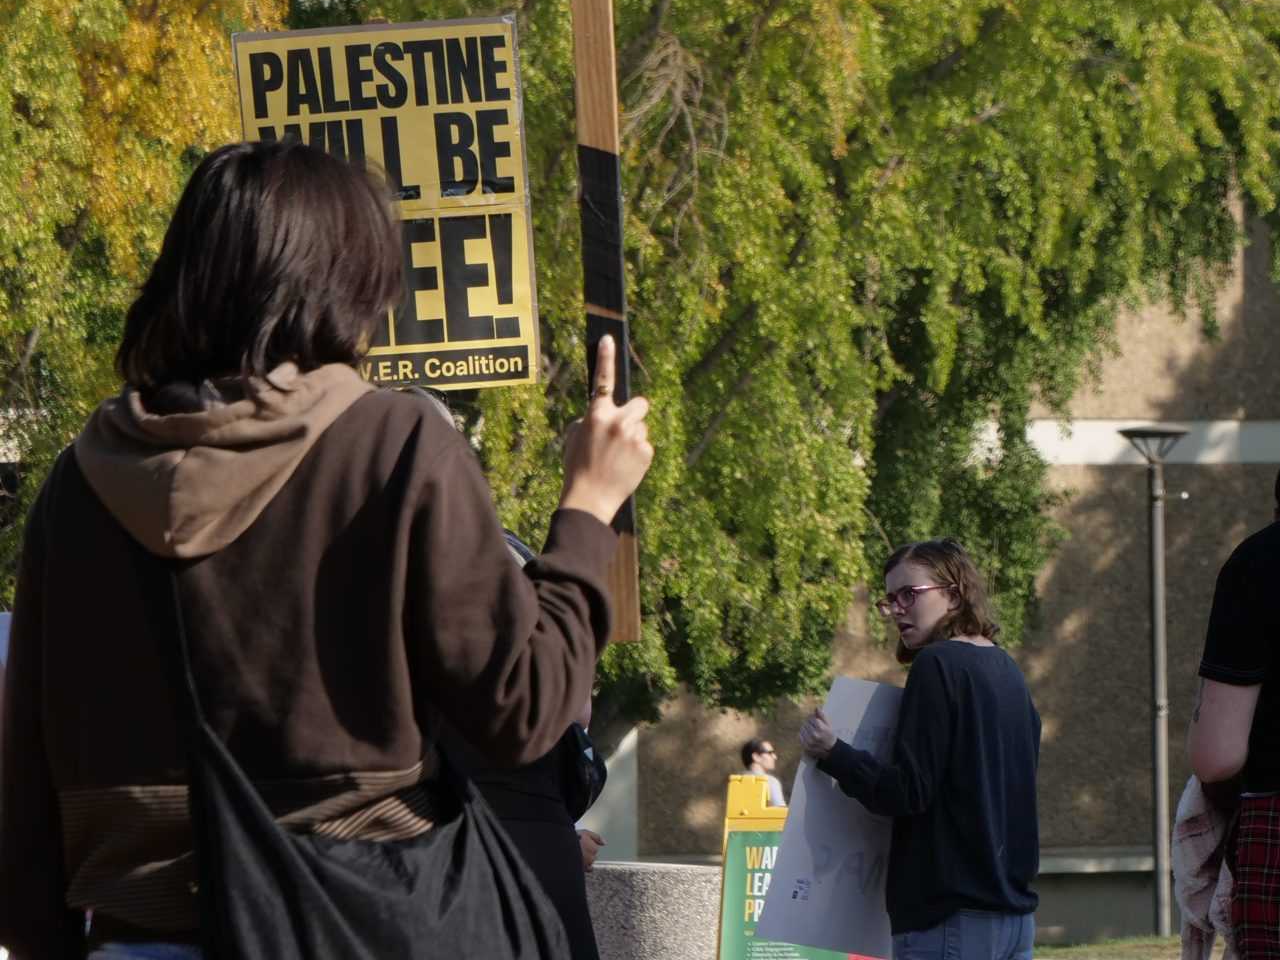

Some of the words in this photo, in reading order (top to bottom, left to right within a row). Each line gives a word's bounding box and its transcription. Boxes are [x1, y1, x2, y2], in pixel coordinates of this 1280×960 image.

[249, 35, 511, 119] PALESTINE
[433, 109, 515, 198] BE
[368, 213, 521, 348] EE!
[425, 355, 523, 379] Coalition
